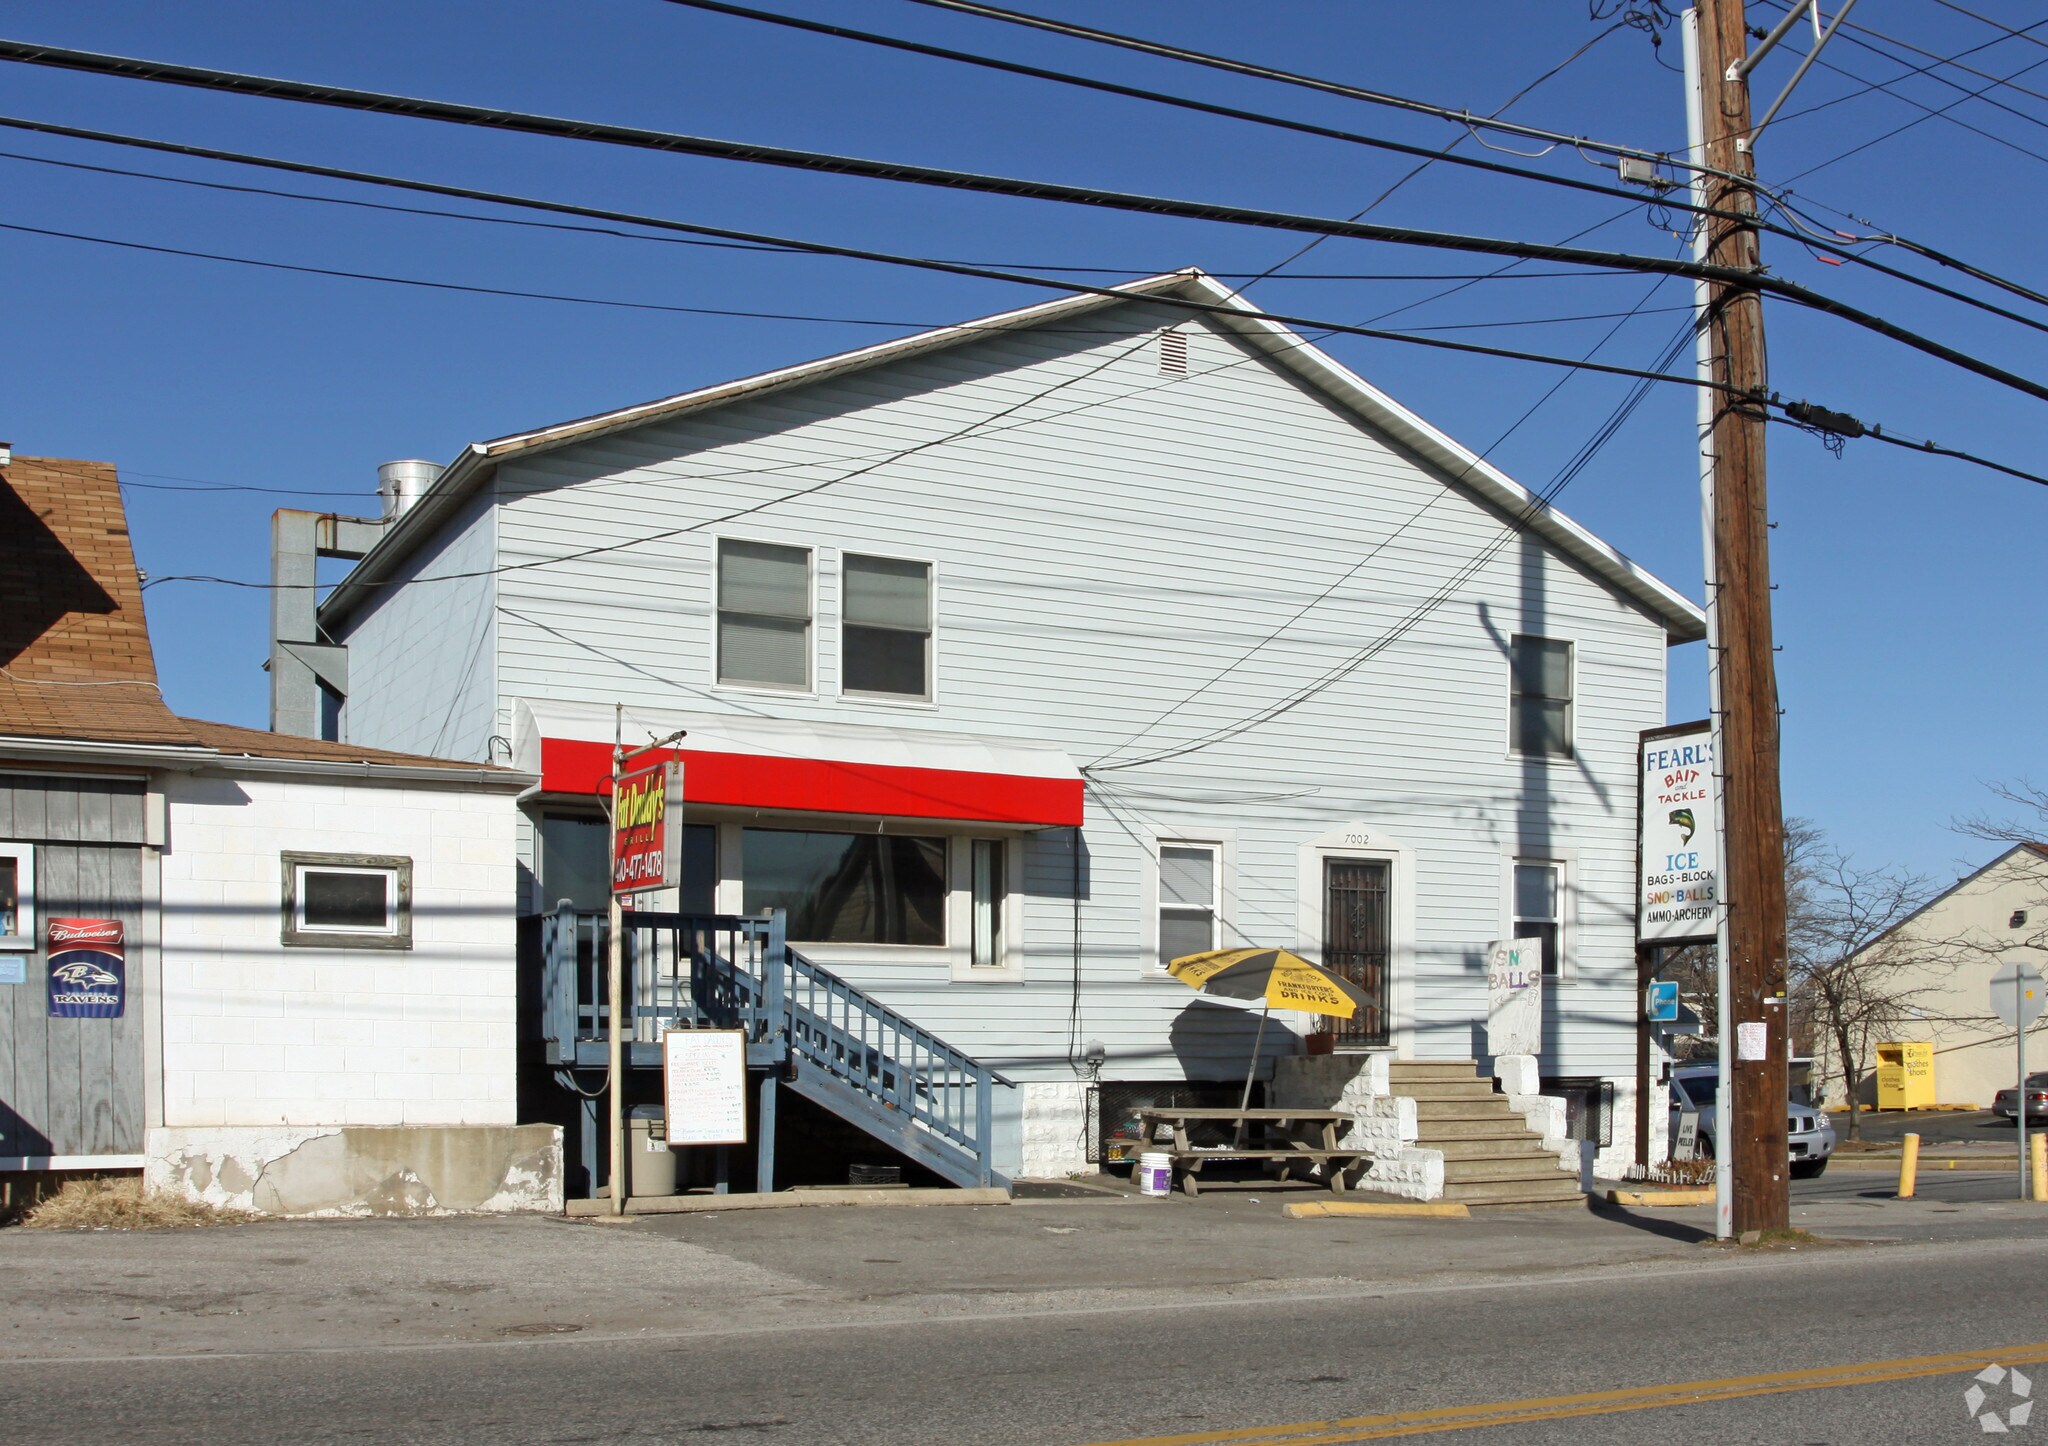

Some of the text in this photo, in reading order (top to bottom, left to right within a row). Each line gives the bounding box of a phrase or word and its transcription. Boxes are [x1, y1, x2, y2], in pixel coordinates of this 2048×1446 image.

[1664, 769, 1700, 788] BAIT
[1675, 782, 1688, 790] and
[1658, 789, 1706, 804] TACKLE
[617, 774, 664, 842] Fat Daddy's
[1345, 834, 1369, 844] 7002
[616, 850, 662, 882] 410-477-1478
[1666, 852, 1699, 871] ICE
[50, 929, 118, 941] Budweiser
[1306, 973, 1321, 982] HOT
[1488, 970, 1541, 990] BALLS
[1277, 981, 1335, 993] FRANKFURTERS
[54, 994, 119, 1004] RAVENS
[1280, 991, 1340, 1005] DRINKS
